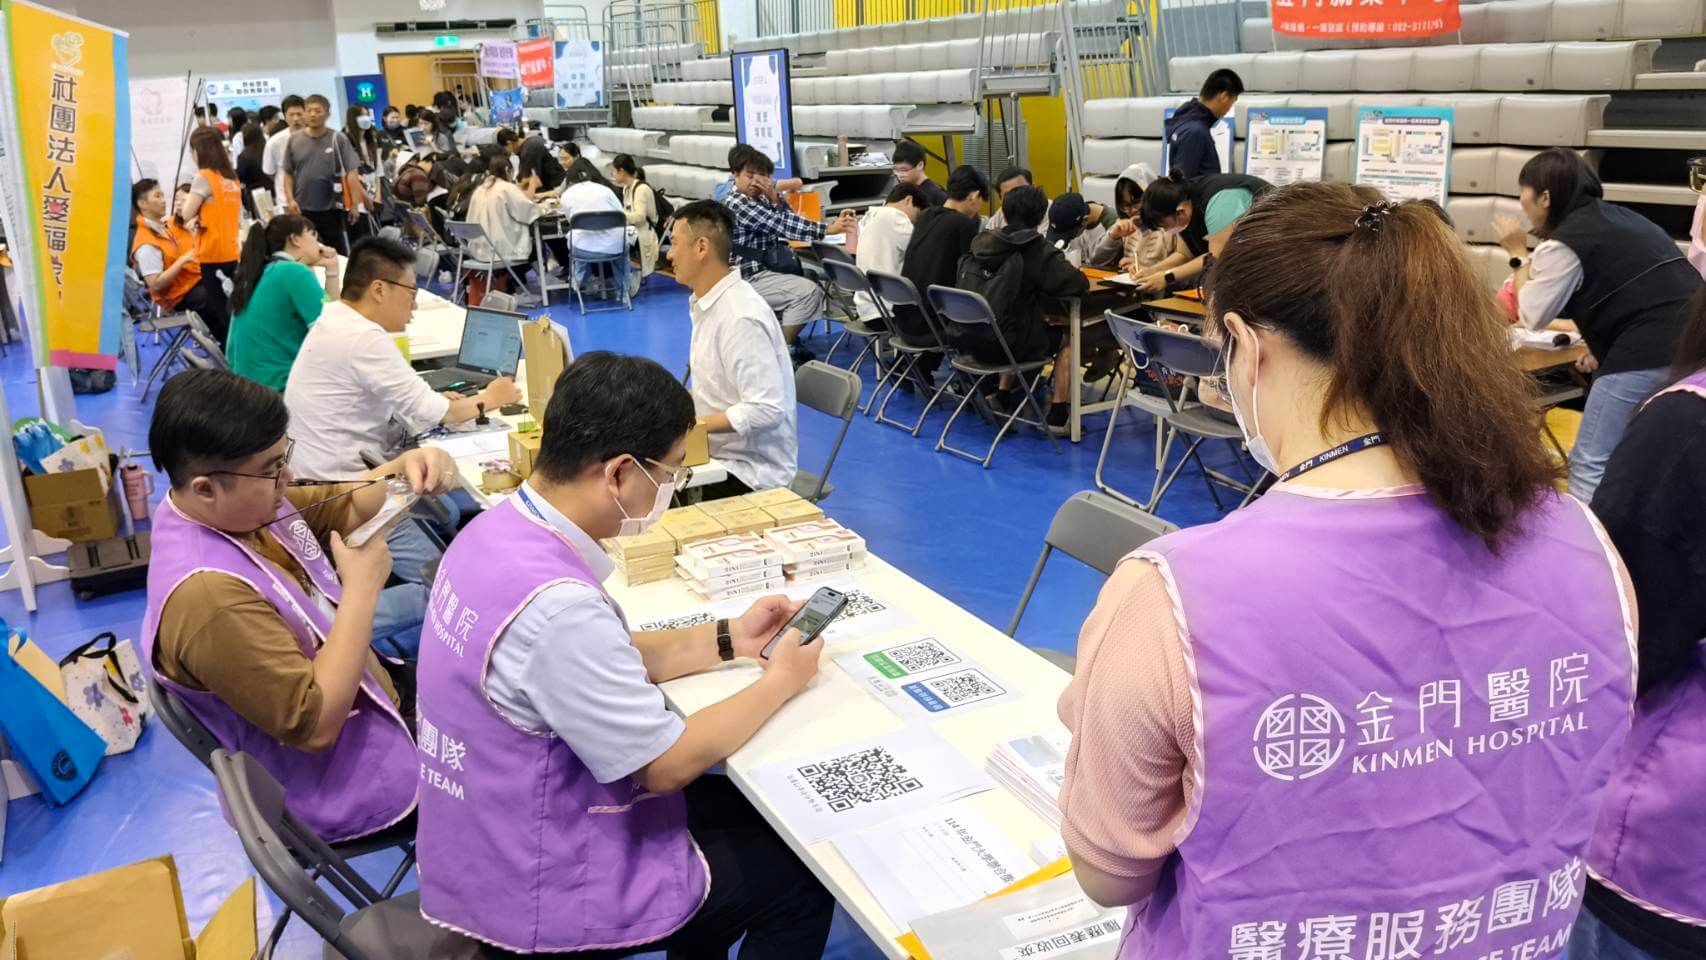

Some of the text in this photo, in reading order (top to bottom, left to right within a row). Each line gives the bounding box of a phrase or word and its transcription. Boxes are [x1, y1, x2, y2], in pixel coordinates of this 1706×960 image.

[1319, 445, 1349, 462] KINMEN
[433, 622, 466, 658] HOSPITAL
[1355, 651, 1590, 747] 金門醫院
[1351, 711, 1589, 774] KINMEN HOSPITAL
[427, 767, 465, 801] TEAM
[945, 817, 960, 829] 114
[1228, 855, 1582, 960] 醫療服務團隊
[1510, 922, 1574, 960] TEAM
